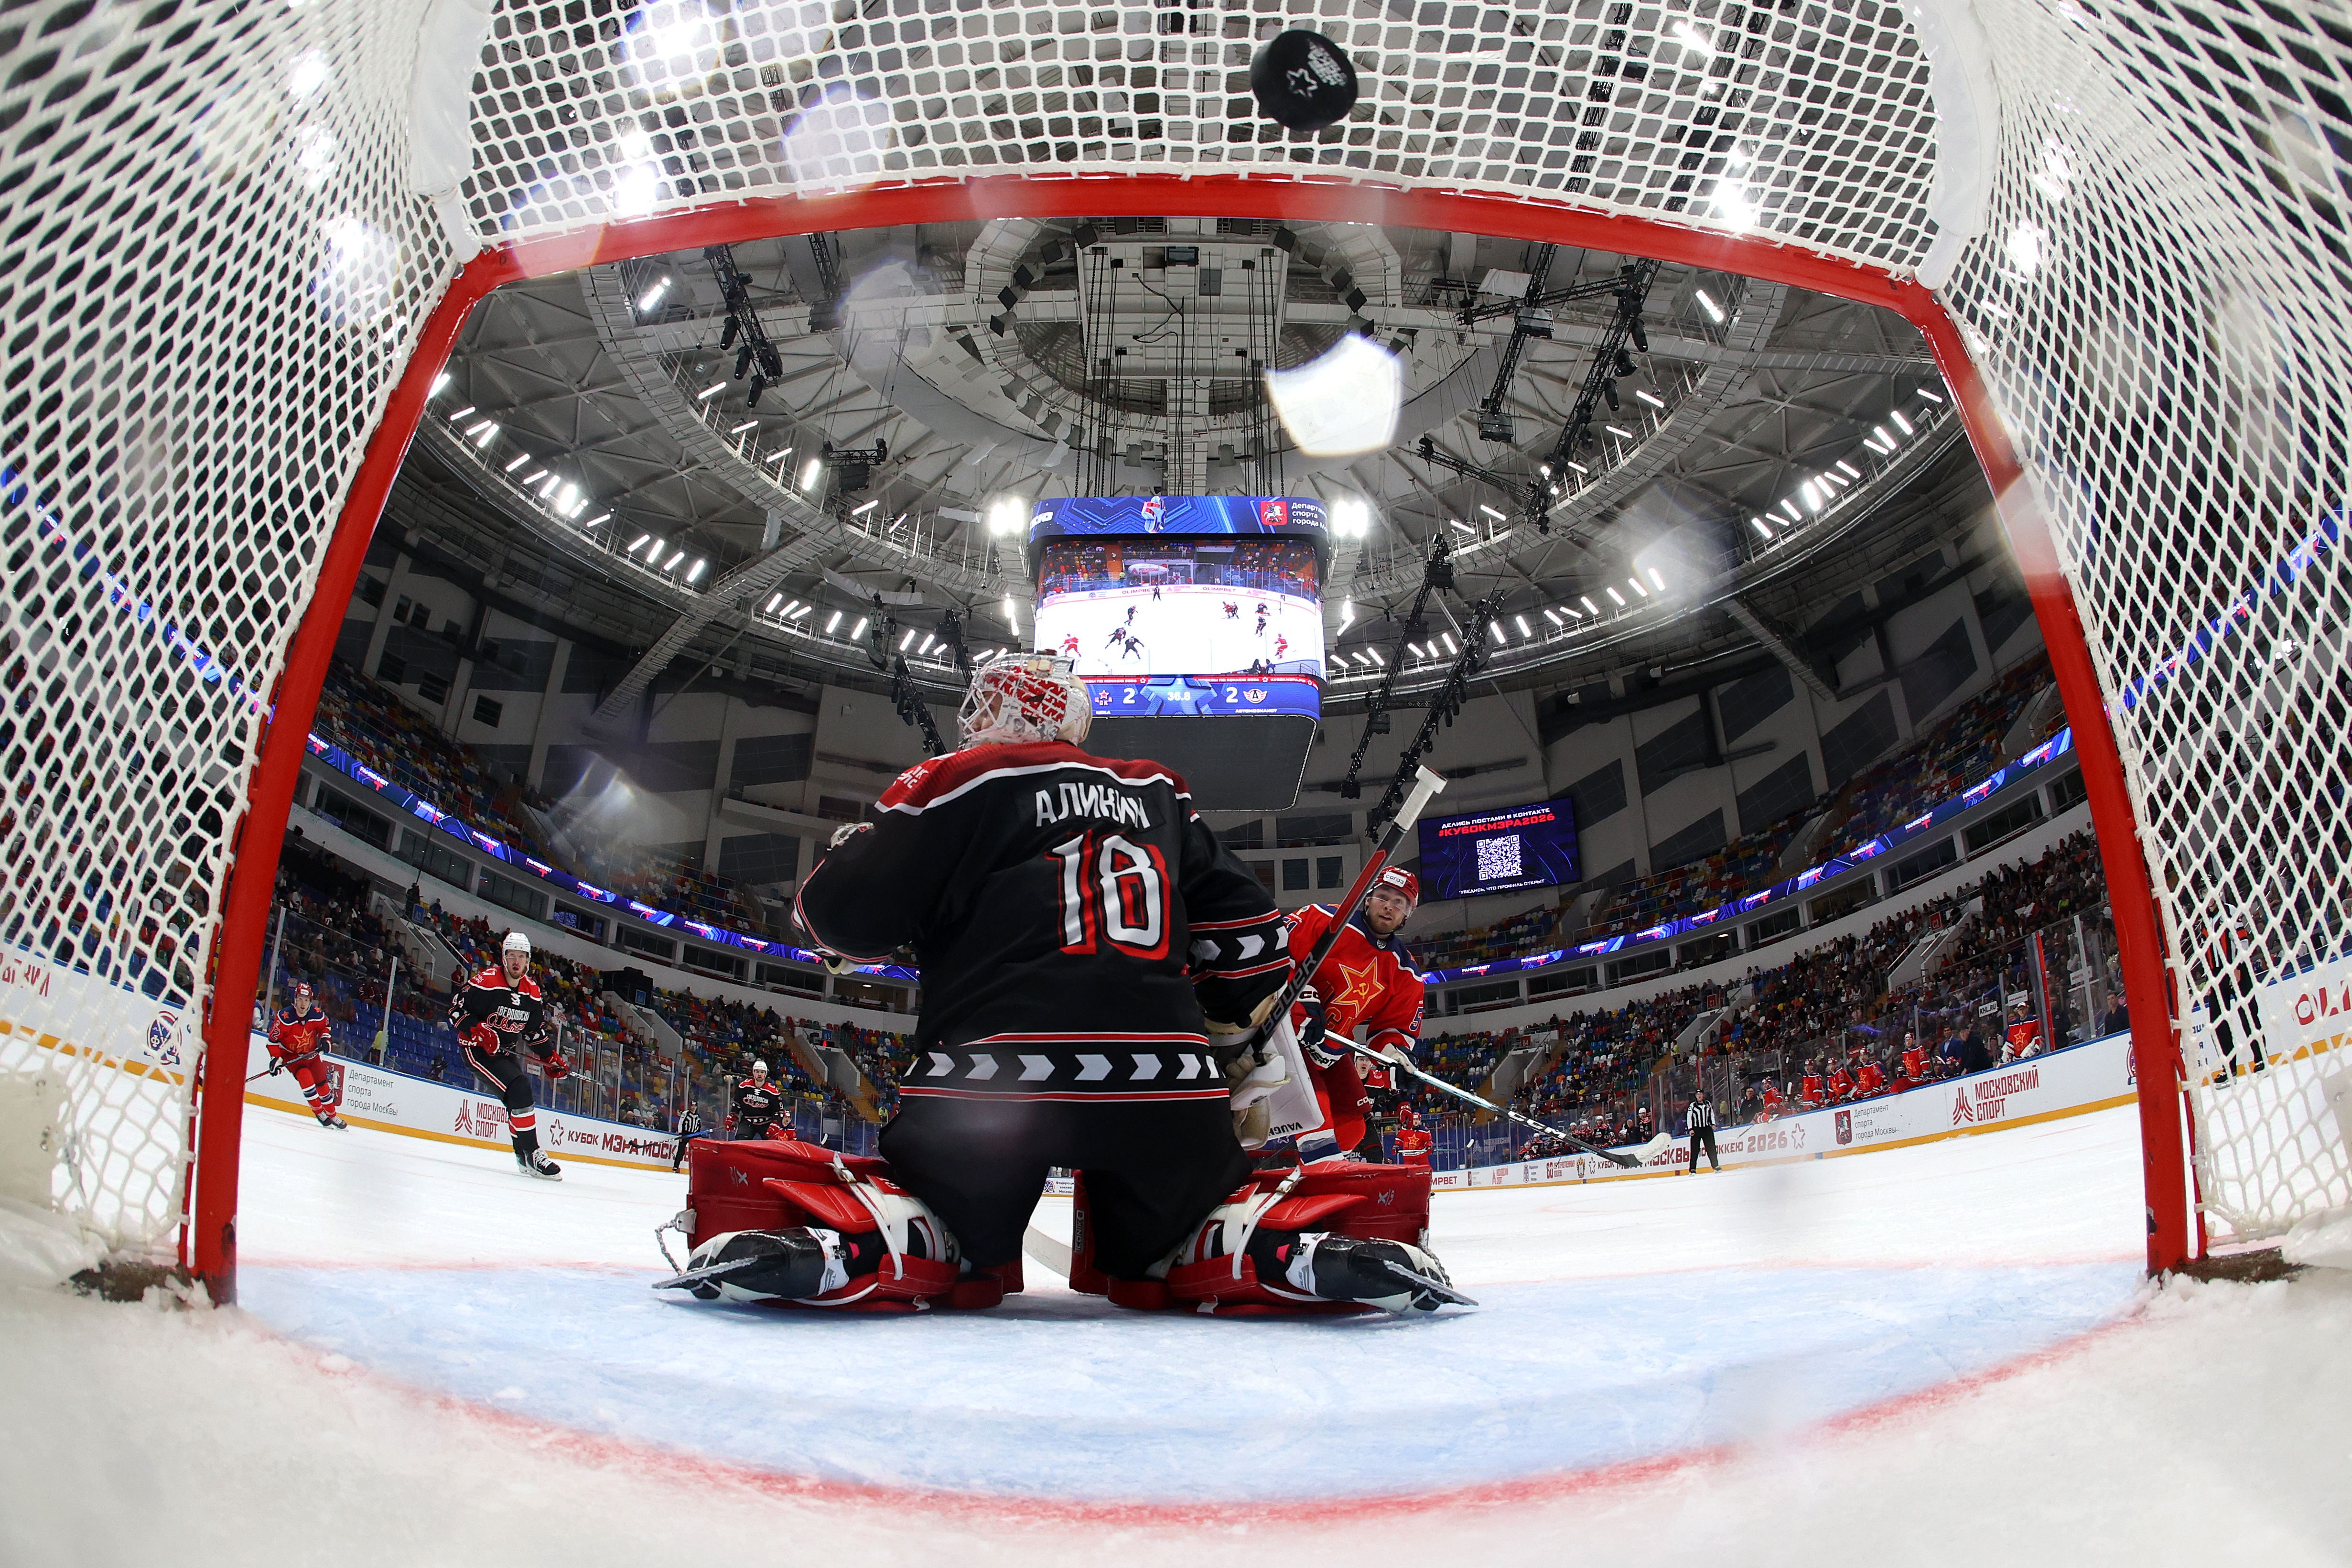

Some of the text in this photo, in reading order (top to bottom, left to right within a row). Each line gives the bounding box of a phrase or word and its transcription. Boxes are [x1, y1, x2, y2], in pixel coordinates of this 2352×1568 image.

[1292, 510, 1318, 519] спорта
[1293, 519, 1319, 527] города
[1123, 688, 1135, 704] 2
[1167, 691, 1191, 701] 36.8
[1226, 687, 1238, 703] 2
[1962, 779, 1993, 800] FAHRENHEIT
[1035, 780, 1151, 830] АЛИКИН
[1439, 813, 1556, 837] #КУБОКМЭРА2026
[1442, 820, 1470, 830] ДЕЛИСЬ
[1471, 815, 1506, 824] ПОСТАМИ
[1513, 808, 1550, 819] КОНТАКТЕ
[1905, 811, 1933, 831] FAHRENHEIT
[1385, 874, 1404, 884] согаз
[1497, 882, 1523, 891] ПРОФИЛЬ
[1462, 964, 1491, 974] FAHRENHEIT
[1979, 1003, 1996, 1014] KHL.RU
[349, 1069, 394, 1089] Департамент
[1974, 1065, 2039, 1102] МОСКОВСКИЙ
[348, 1084, 372, 1097] спорта
[347, 1098, 398, 1116] города Москвы
[1854, 1103, 1889, 1119] Департамент
[1976, 1098, 2006, 1122] СПОРТ
[475, 1120, 498, 1139] СПОРТ
[1269, 1121, 1304, 1136] VAUGH
[1855, 1120, 1873, 1129] спорта
[568, 1130, 599, 1146] КУБОК
[1855, 1126, 1897, 1140] города Москвы
[1597, 1161, 1614, 1169] КУБОК
[1747, 1131, 1788, 1153] 2026
